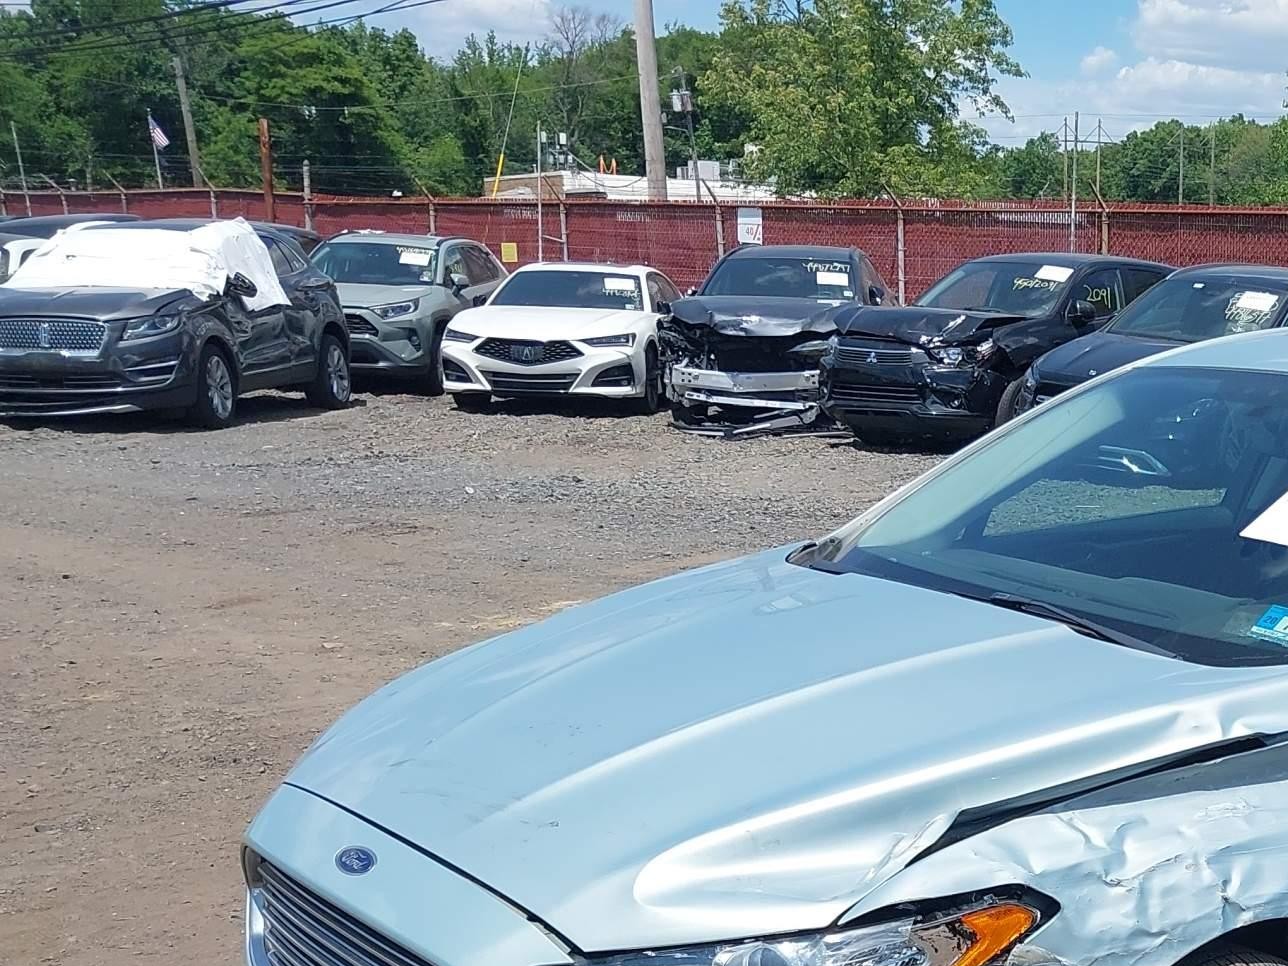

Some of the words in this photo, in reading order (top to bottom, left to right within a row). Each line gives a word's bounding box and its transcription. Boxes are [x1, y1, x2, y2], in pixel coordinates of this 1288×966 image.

[1083, 284, 1111, 309] 2091
[1263, 615, 1279, 625] 20
[341, 851, 369, 870] Ford
